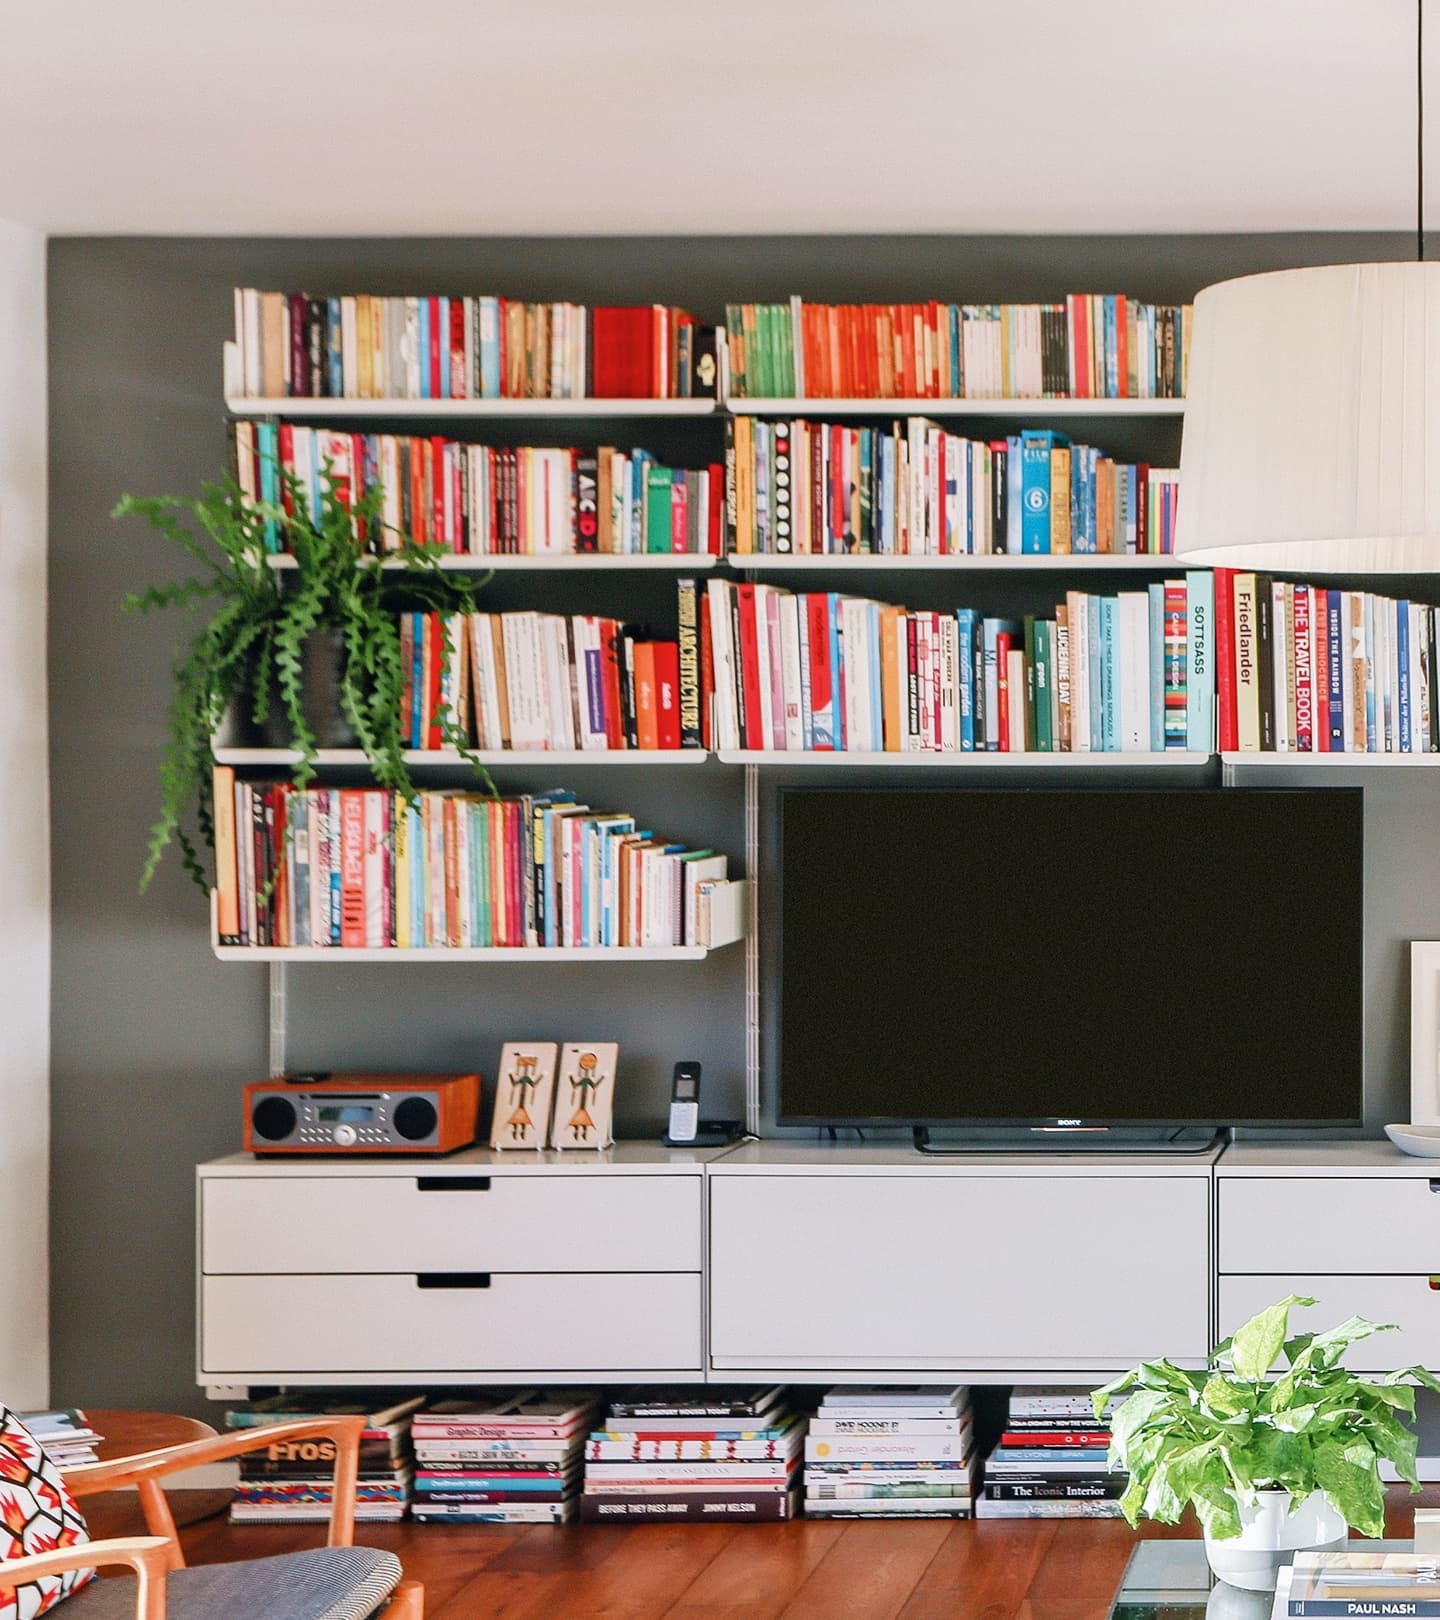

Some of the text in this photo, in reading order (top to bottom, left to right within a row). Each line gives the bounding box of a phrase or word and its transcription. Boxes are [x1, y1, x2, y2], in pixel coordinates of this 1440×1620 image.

[1030, 490, 1043, 508] 6
[1194, 606, 1205, 675] SOTTSASS
[1239, 592, 1253, 686] Friedlander
[1331, 609, 1340, 695] INSIDE THE RAINBOW
[959, 647, 970, 682] modern
[1037, 661, 1046, 688] green
[1057, 626, 1071, 705] LUCIENNE DAY
[1295, 597, 1311, 731] THE TRAVEL BOOK
[680, 626, 699, 731] ARCHITECTURE
[910, 673, 918, 692] LOST
[959, 683, 971, 717] garden
[707, 1408, 731, 1416] TODAY
[447, 1426, 507, 1438] Graphic Design
[269, 1441, 336, 1461] Fros
[1012, 1485, 1106, 1496] The Iconic Interior
[598, 1503, 756, 1514] BEFORE THEY PASS AWAY JIMMY NELSON
[1347, 1602, 1416, 1614] PAUL NASH
